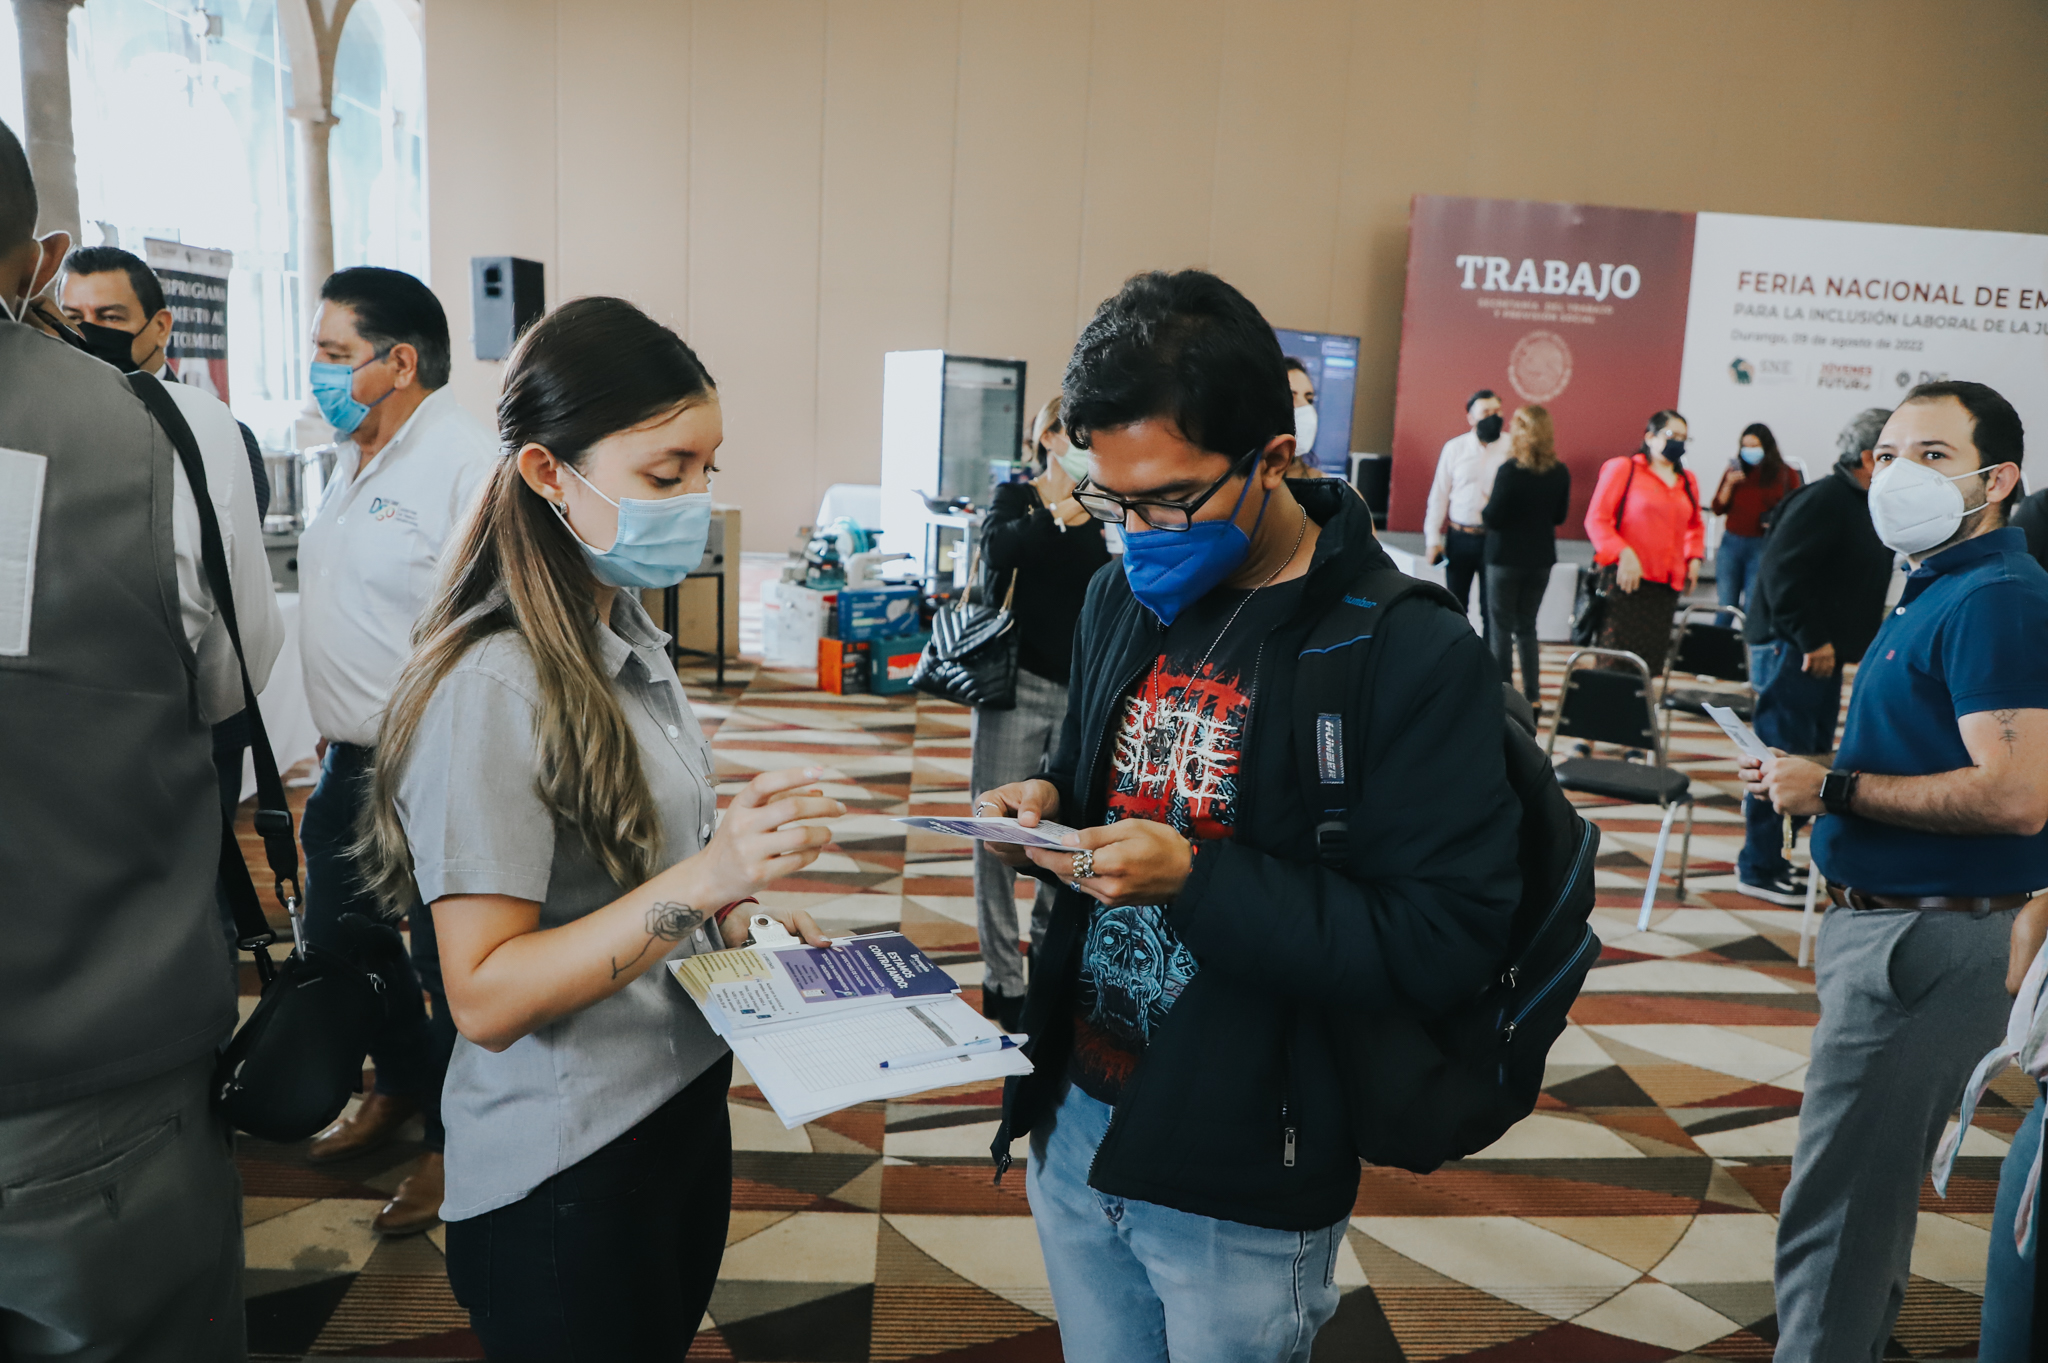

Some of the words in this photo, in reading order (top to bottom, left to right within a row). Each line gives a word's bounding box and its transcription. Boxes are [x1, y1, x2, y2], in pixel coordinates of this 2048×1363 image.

[1456, 255, 1641, 301] TRABAJO
[1738, 271, 1815, 295] FERIA
[1826, 277, 1964, 306] NACIONAL
[1975, 287, 2009, 308] DE
[1733, 302, 1779, 318] PARA
[1784, 306, 1804, 320] LA
[1809, 306, 1898, 325] INCLUSIÓN
[1902, 313, 1979, 332] LABORAL
[1983, 318, 2005, 333] DE
[2010, 320, 2030, 333] LA
[1325, 720, 1337, 779] HUMBER
[868, 944, 909, 989] CONTRATANDO:
[887, 951, 916, 978] ESTAMOS
